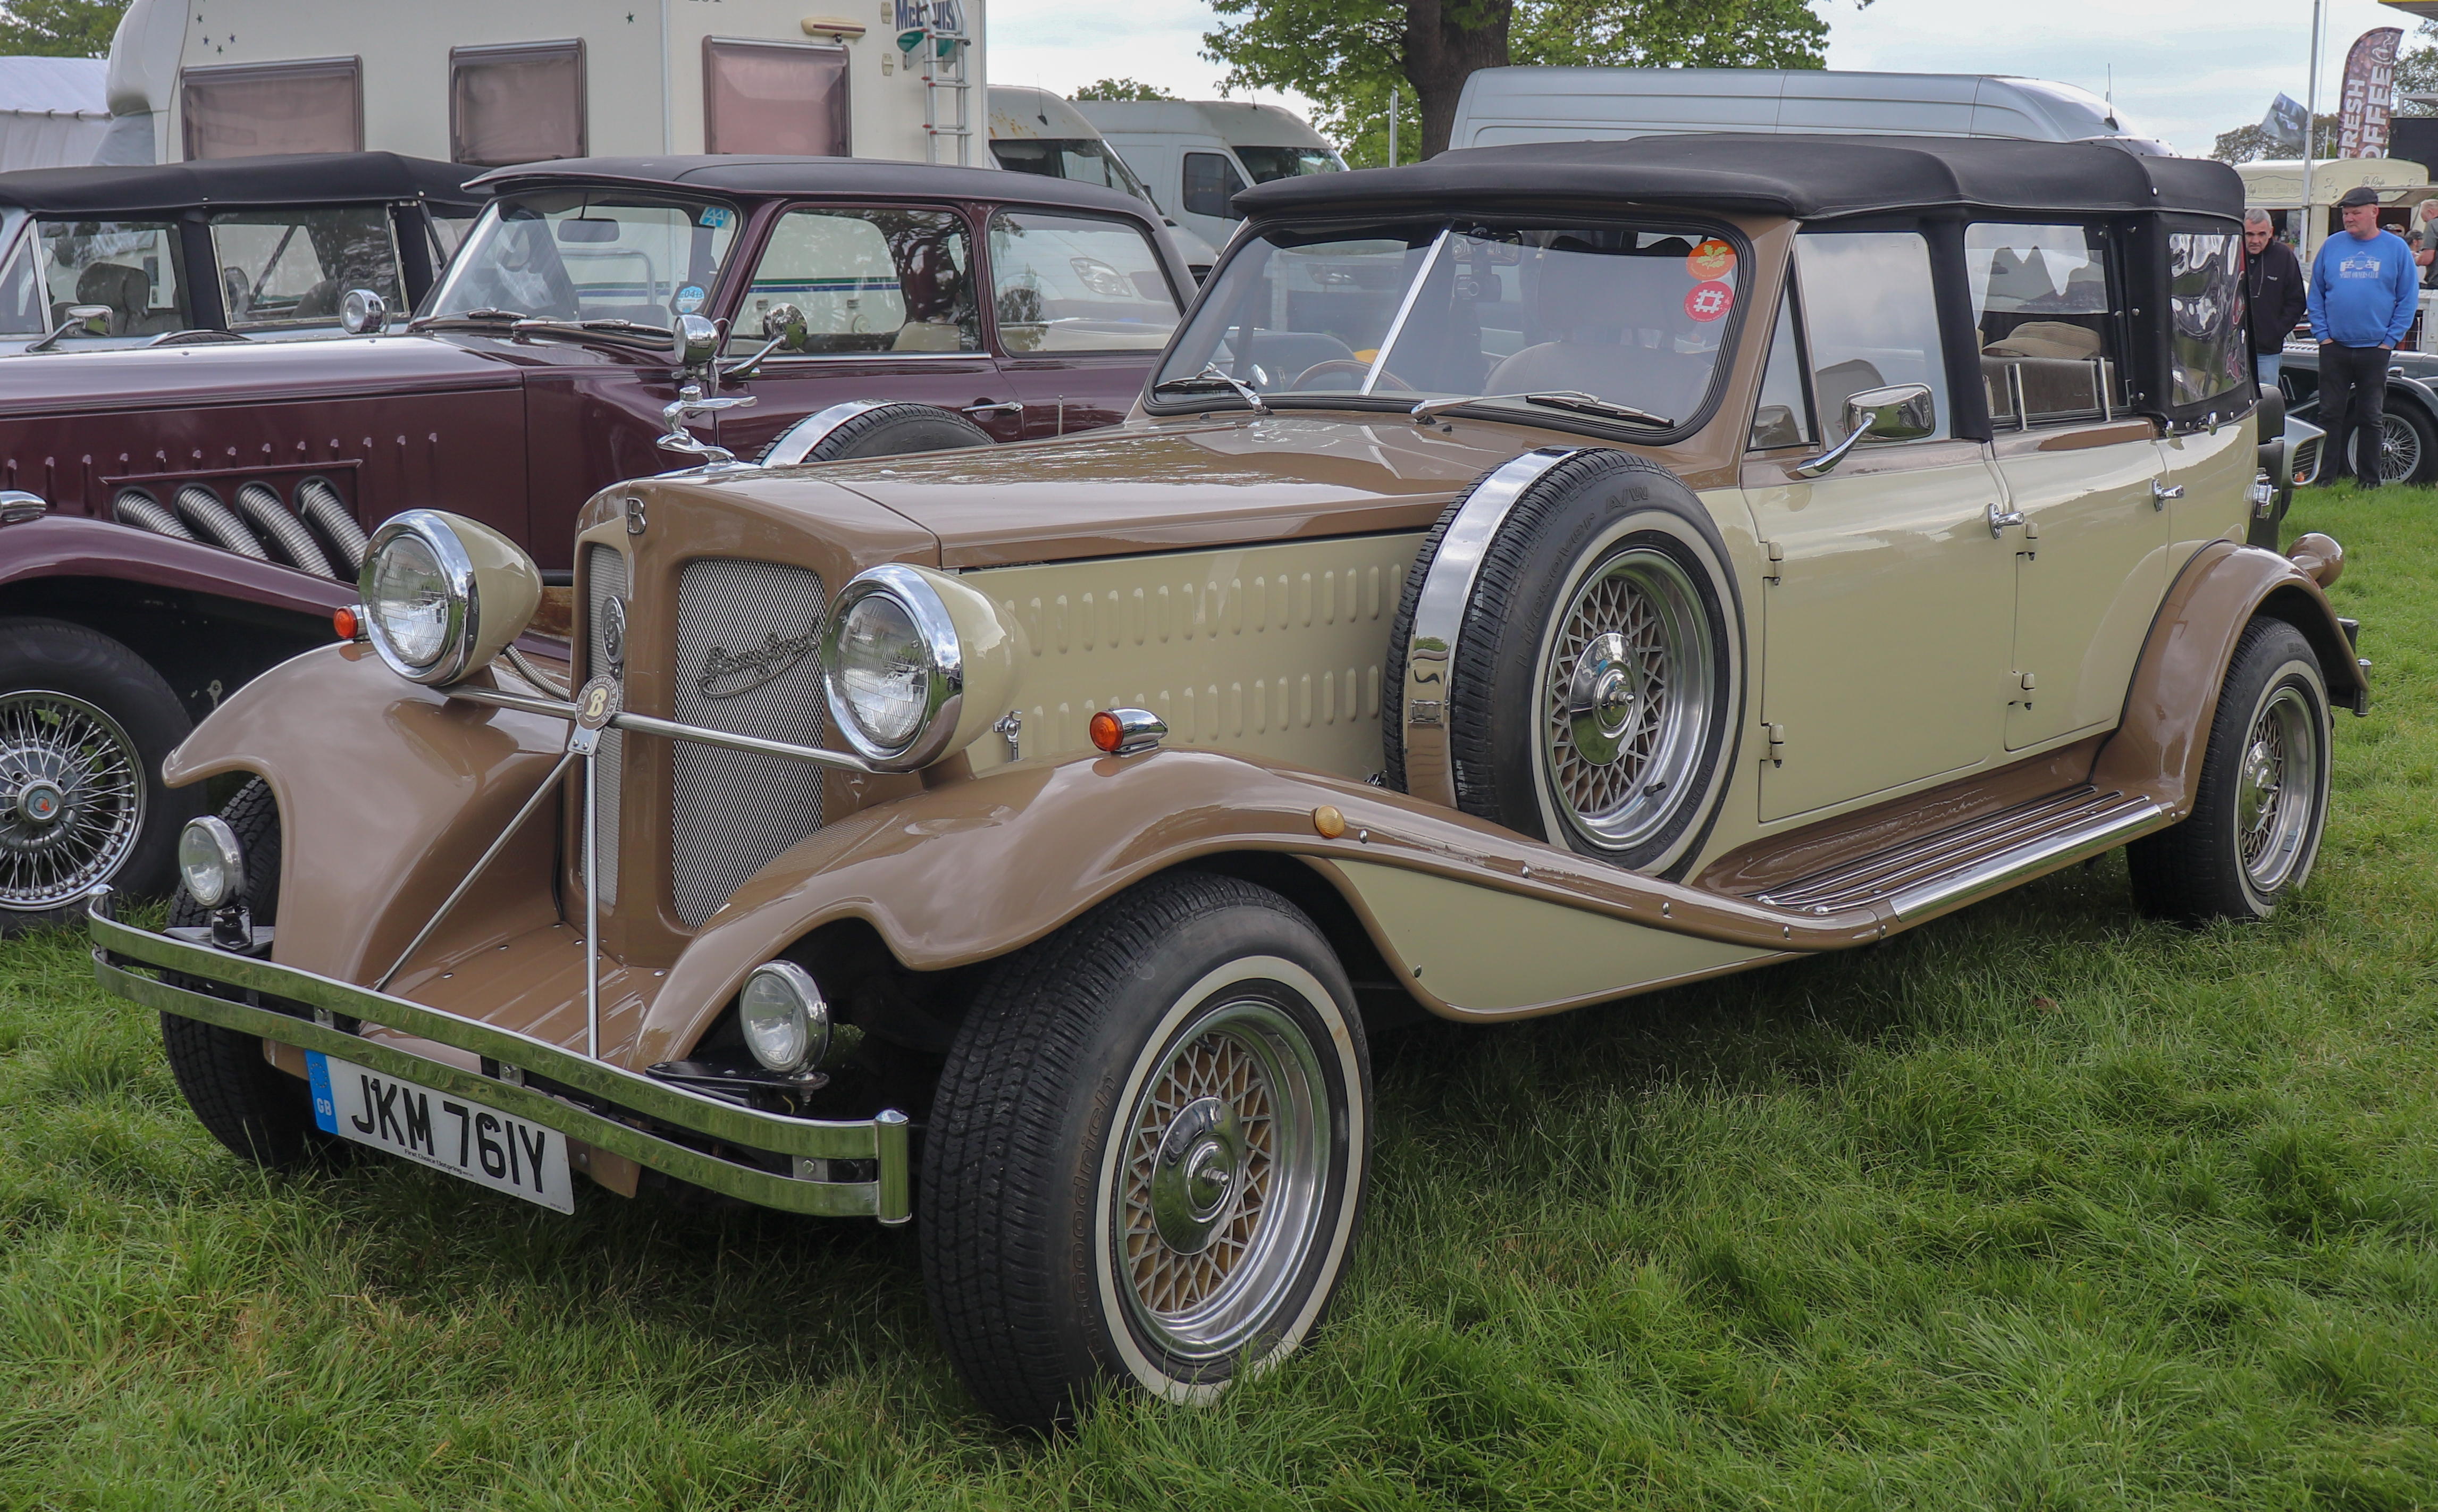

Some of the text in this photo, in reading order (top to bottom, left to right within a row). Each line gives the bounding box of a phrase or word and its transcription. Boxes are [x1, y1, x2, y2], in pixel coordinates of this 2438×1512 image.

[2340, 79, 2366, 159] FRESH
[2360, 66, 2392, 158] OFFEE
[316, 1097, 332, 1117] GB
[351, 1074, 545, 1194] JKM 761Y
[405, 1148, 417, 1158] First
[418, 1153, 436, 1165] Choice
